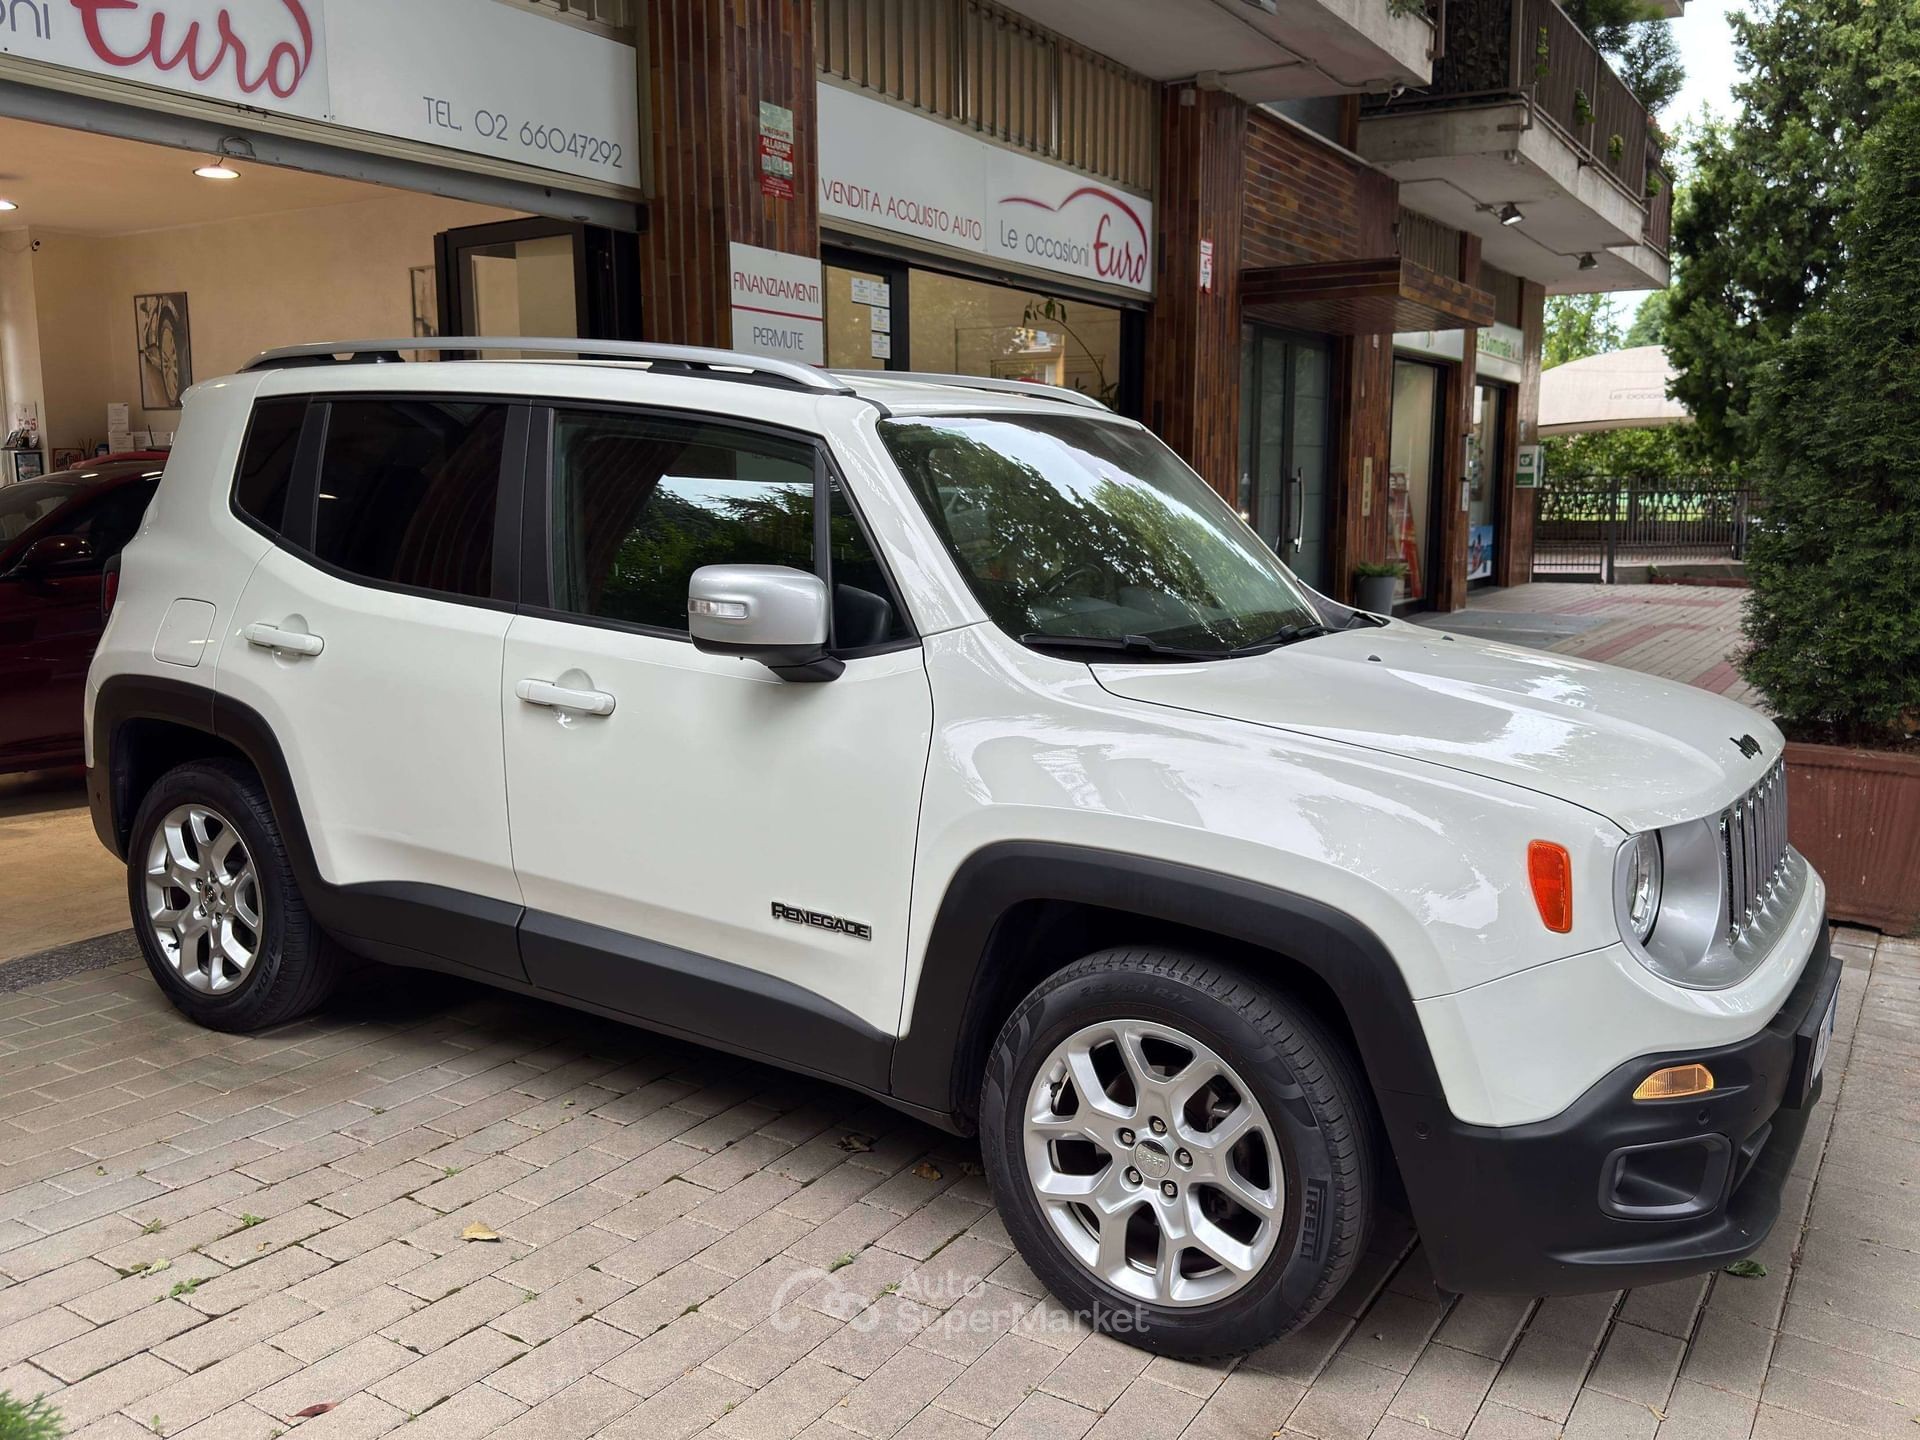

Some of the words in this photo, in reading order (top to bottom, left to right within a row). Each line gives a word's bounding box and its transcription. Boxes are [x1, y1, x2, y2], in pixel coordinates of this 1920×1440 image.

[423, 96, 462, 131] TEL.
[474, 109, 508, 141] 02
[519, 121, 623, 168] 66047292
[886, 196, 950, 232] ACQUISTO
[952, 215, 982, 241] AUTO
[1000, 219, 1018, 249] Le
[1025, 233, 1089, 267] occasioni
[733, 271, 819, 305] FINANZIAMENTI
[753, 326, 805, 350] PERMUTE
[771, 901, 872, 941] RENEGADE
[1299, 1177, 1329, 1264] PIRELLI
